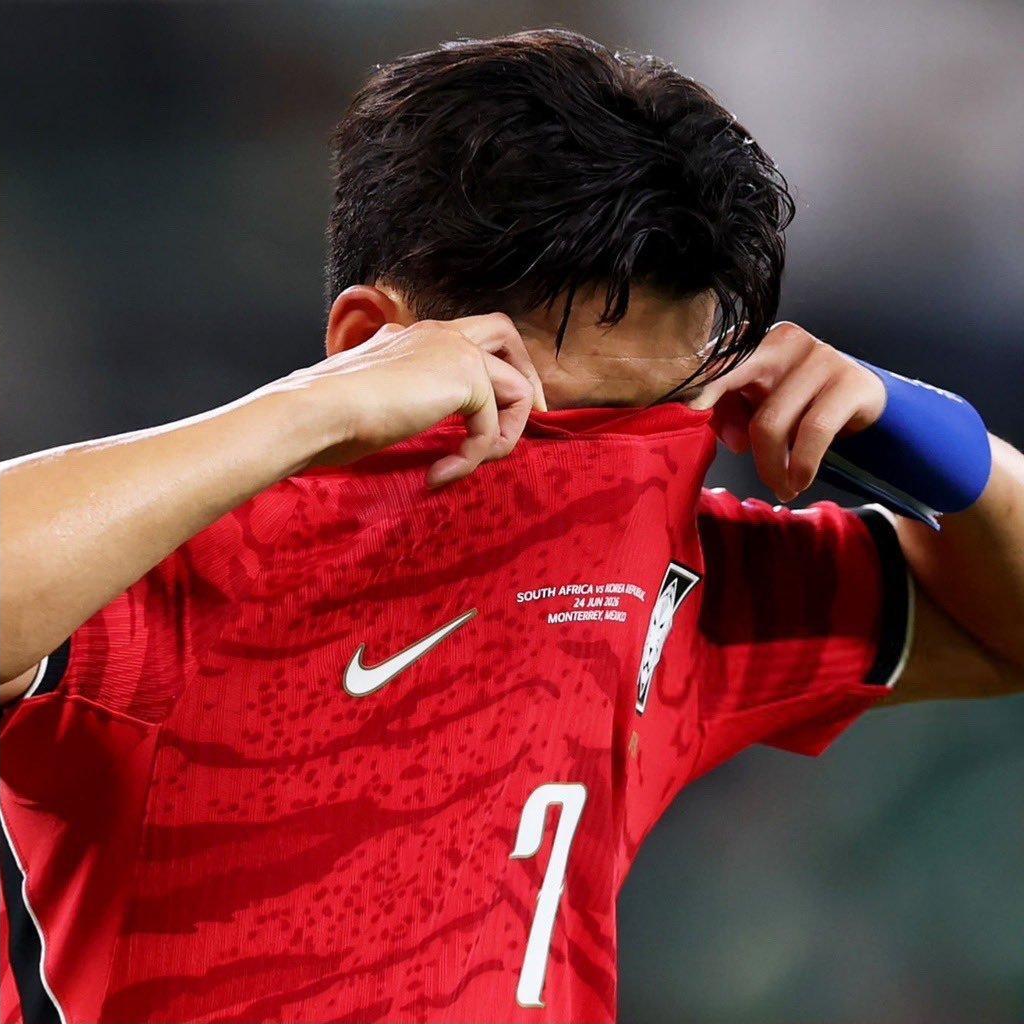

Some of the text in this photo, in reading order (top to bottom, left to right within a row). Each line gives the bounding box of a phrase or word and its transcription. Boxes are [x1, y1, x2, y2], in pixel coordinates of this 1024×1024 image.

[516, 586, 556, 603] SOUTH
[558, 583, 593, 596] AFRICA
[573, 596, 620, 608] 24 JUN 2026
[547, 609, 604, 624] MONTERREY,
[508, 782, 589, 1008] 7
